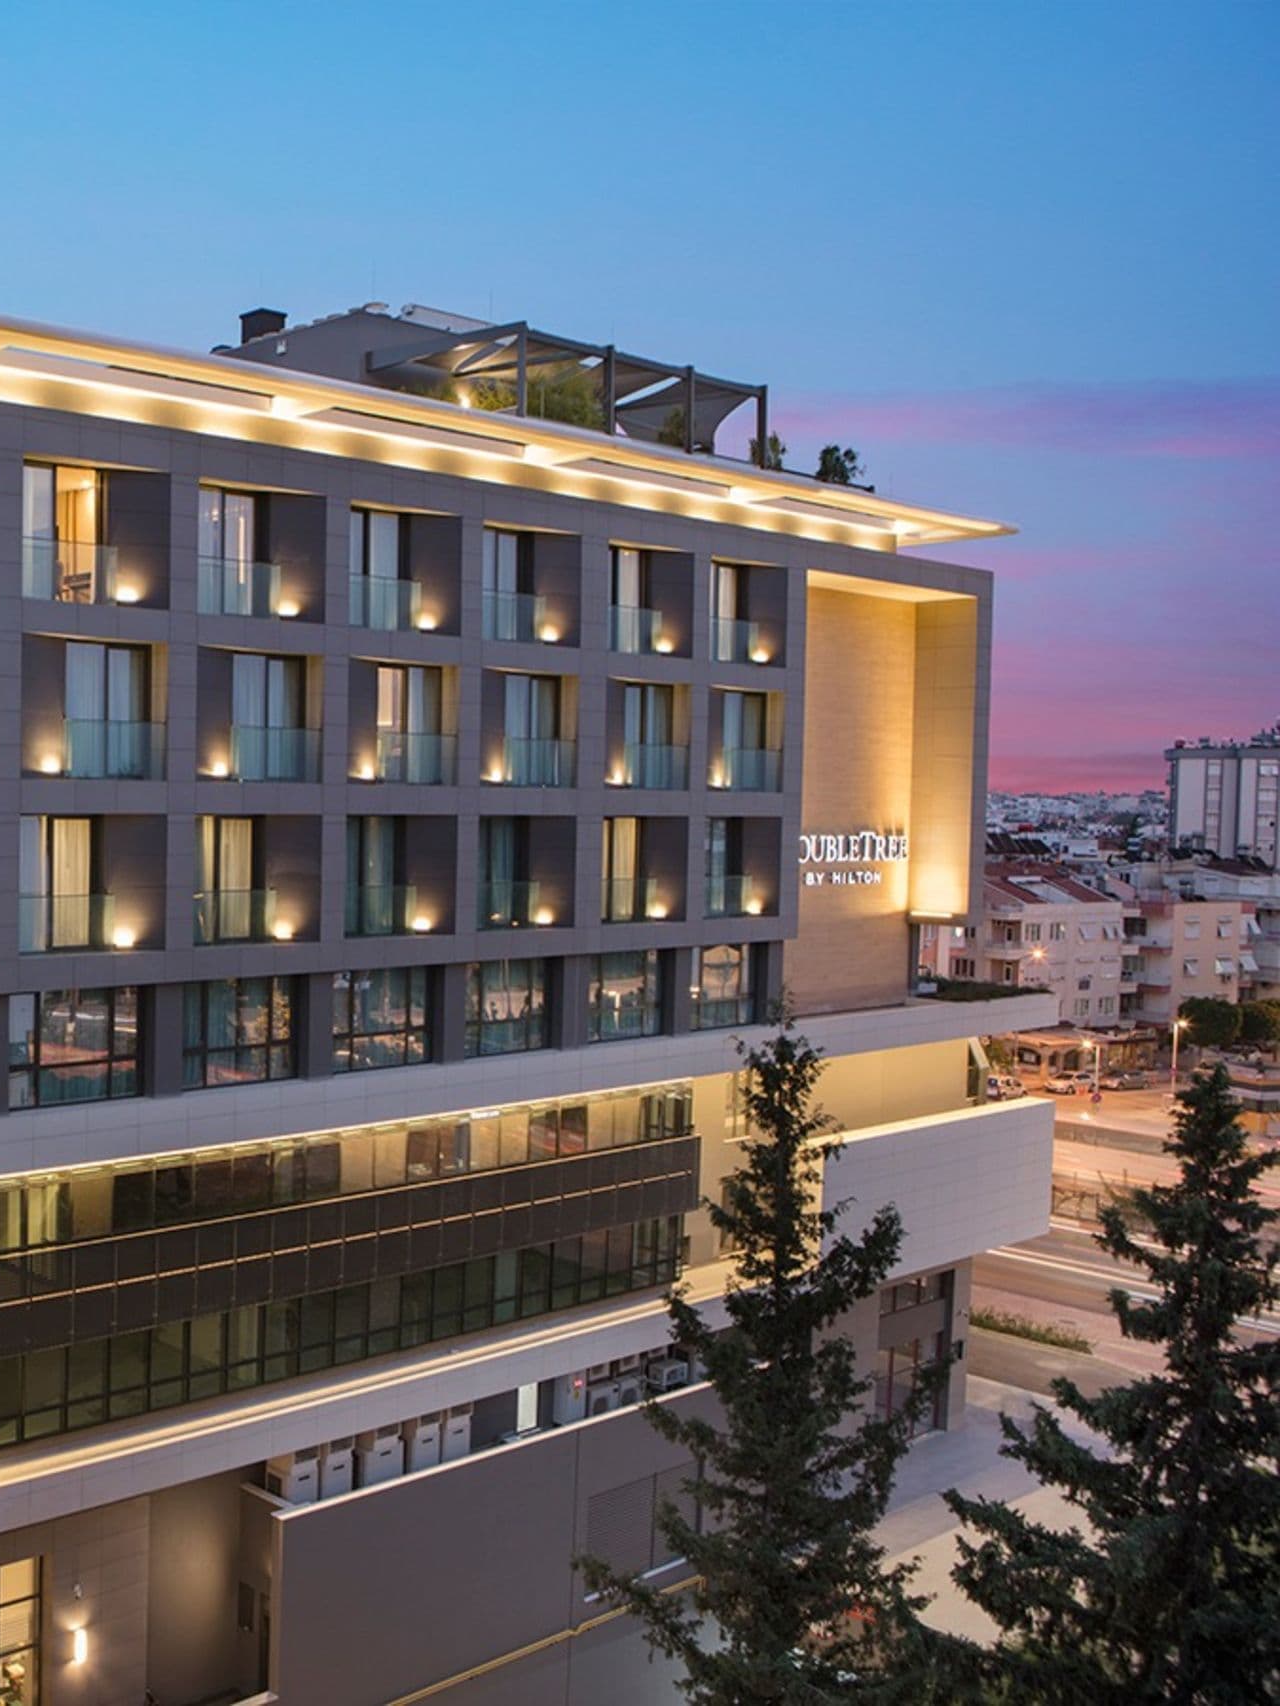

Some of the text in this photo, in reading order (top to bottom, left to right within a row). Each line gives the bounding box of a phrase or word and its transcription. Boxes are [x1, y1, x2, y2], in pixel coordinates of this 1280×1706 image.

[798, 830, 908, 864] OUBLETREE
[805, 871, 882, 886] BY HILTON
